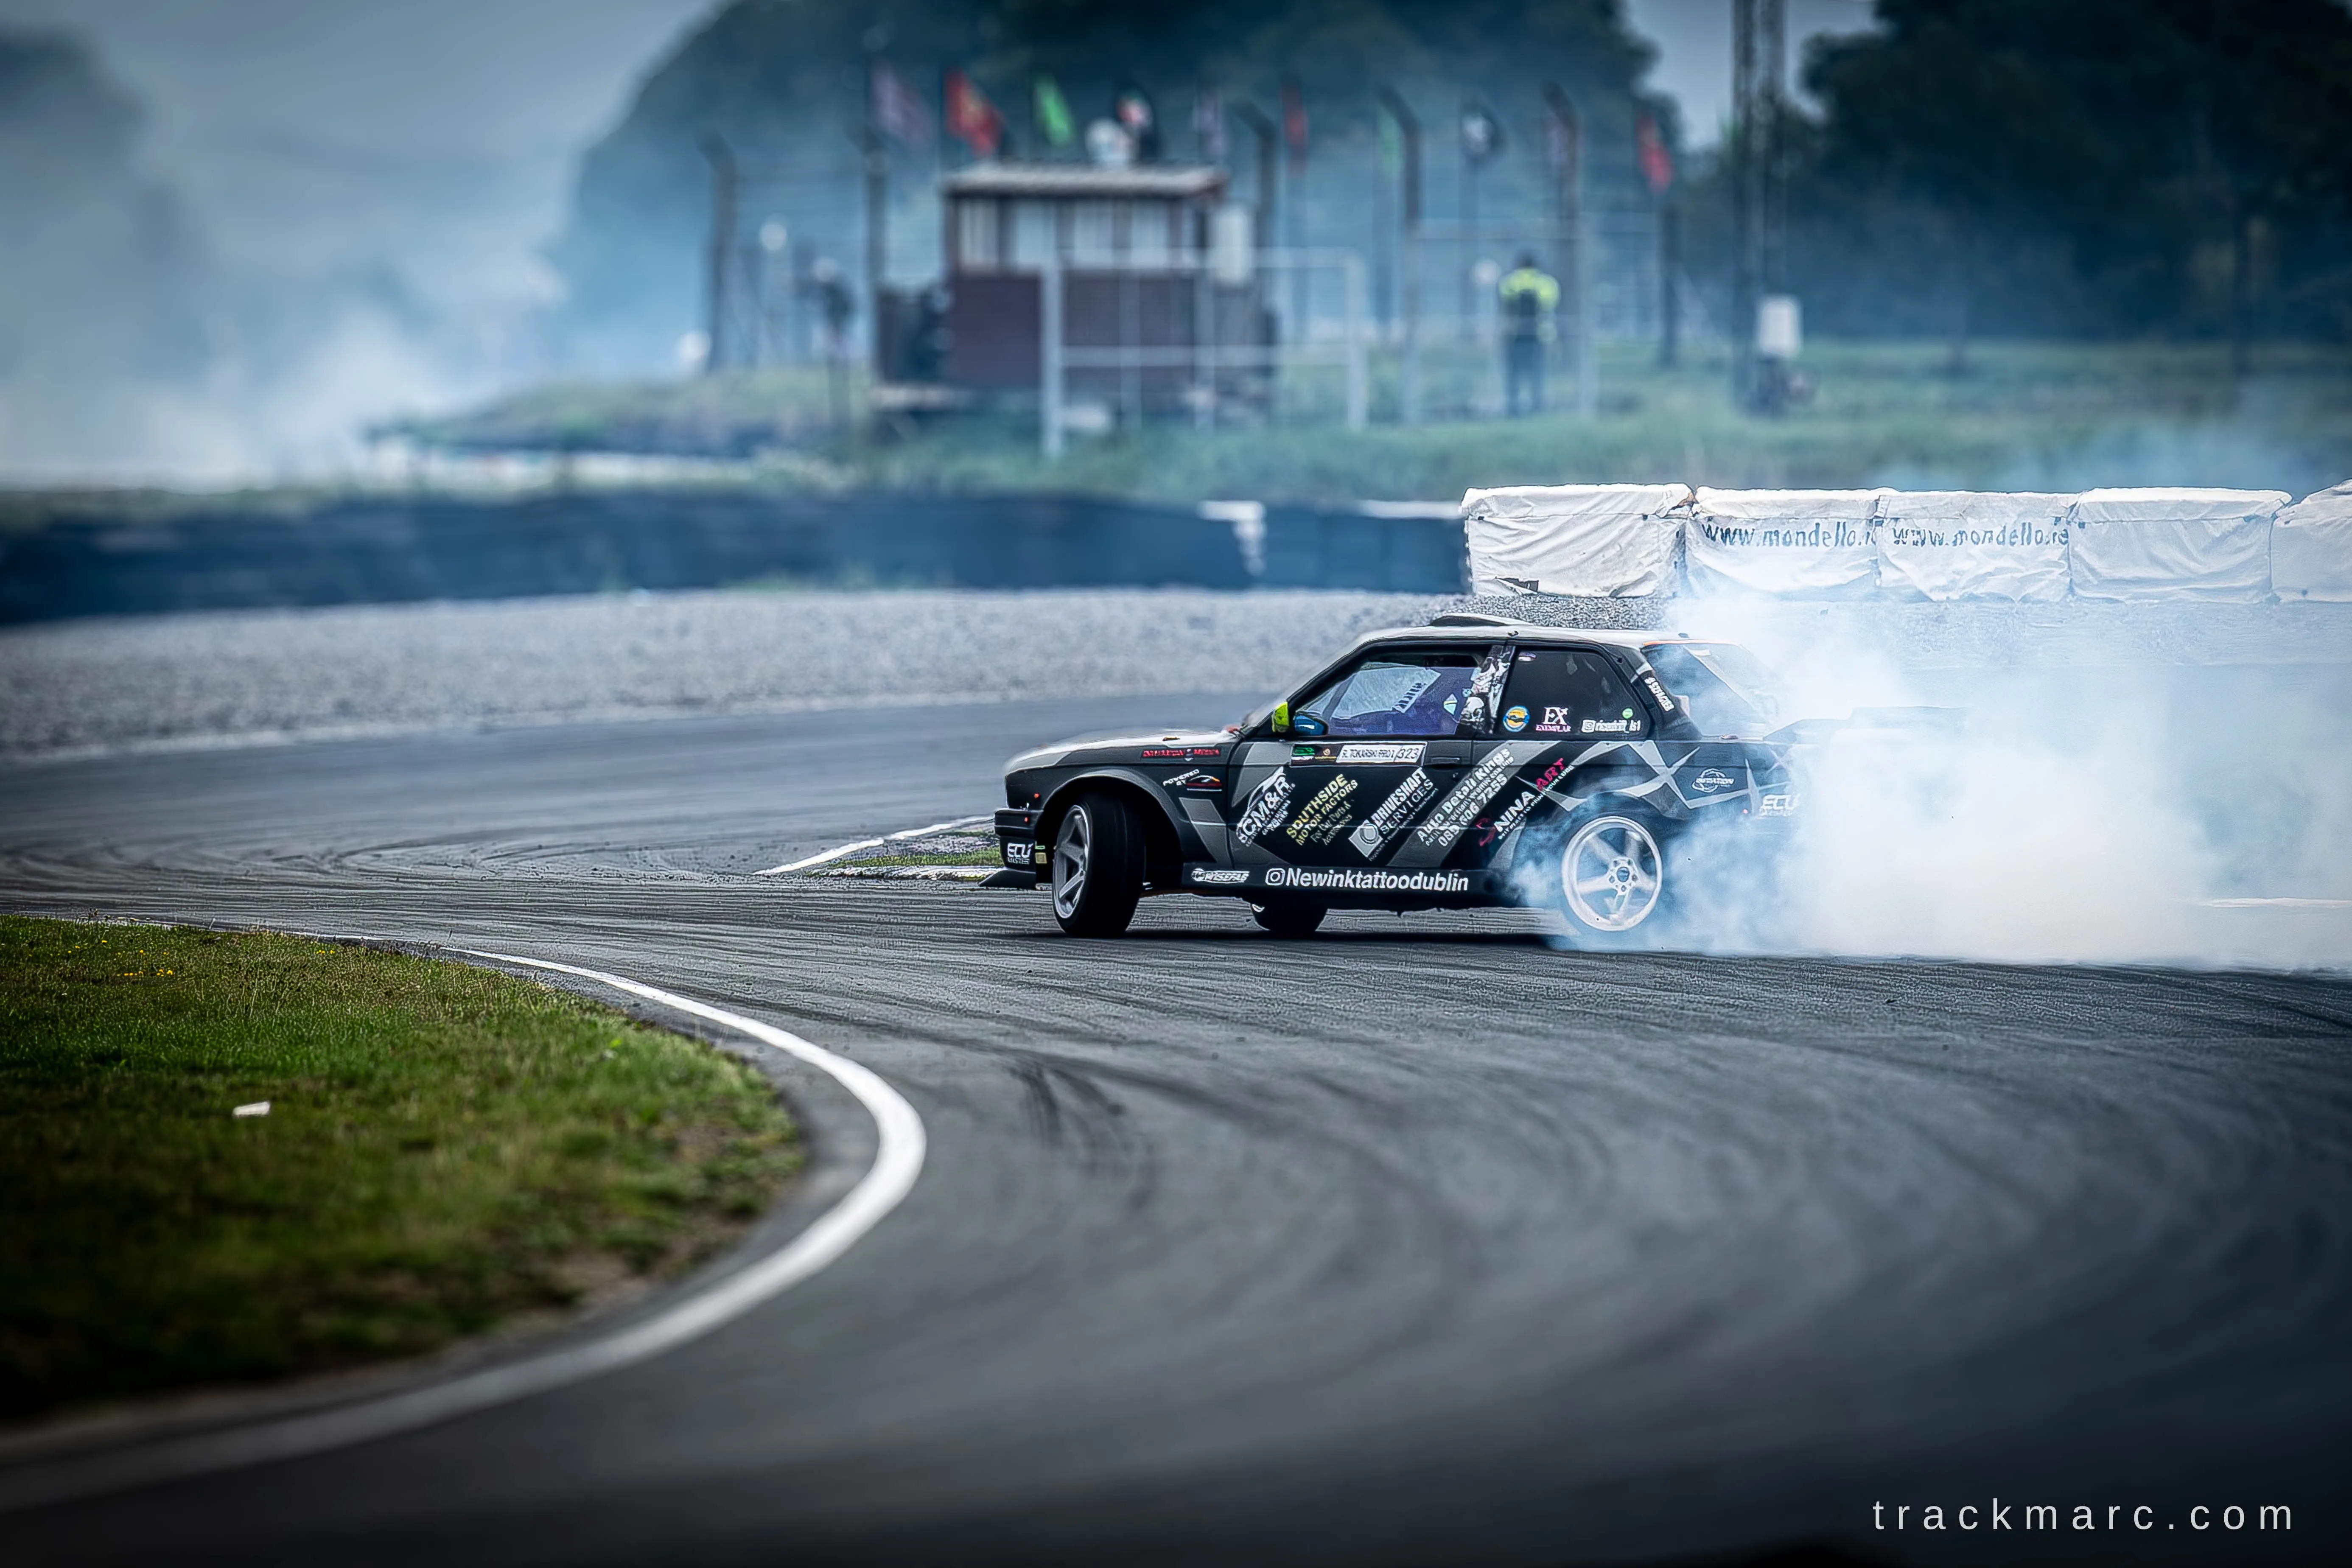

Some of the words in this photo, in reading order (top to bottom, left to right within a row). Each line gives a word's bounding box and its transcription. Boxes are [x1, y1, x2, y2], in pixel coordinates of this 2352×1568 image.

[1543, 707, 1568, 725] EX
[1396, 748, 1419, 759] 323
[1371, 767, 1427, 827] DRIVESHAFT
[1442, 778, 1477, 814] Detail
[1474, 748, 1511, 781] Kings
[1477, 773, 1508, 804] 7255
[1494, 791, 1535, 833] NINA
[1535, 757, 1565, 791] ART
[1763, 794, 1800, 810] ECU
[1286, 773, 1348, 839] SOUTHSIDE
[1295, 813, 1323, 846] MOTOR
[1321, 779, 1358, 815] FACTORS
[1380, 779, 1434, 834] SERVICES
[1007, 843, 1034, 858] ECU
[1286, 868, 1469, 891] Newinktattoodublin
